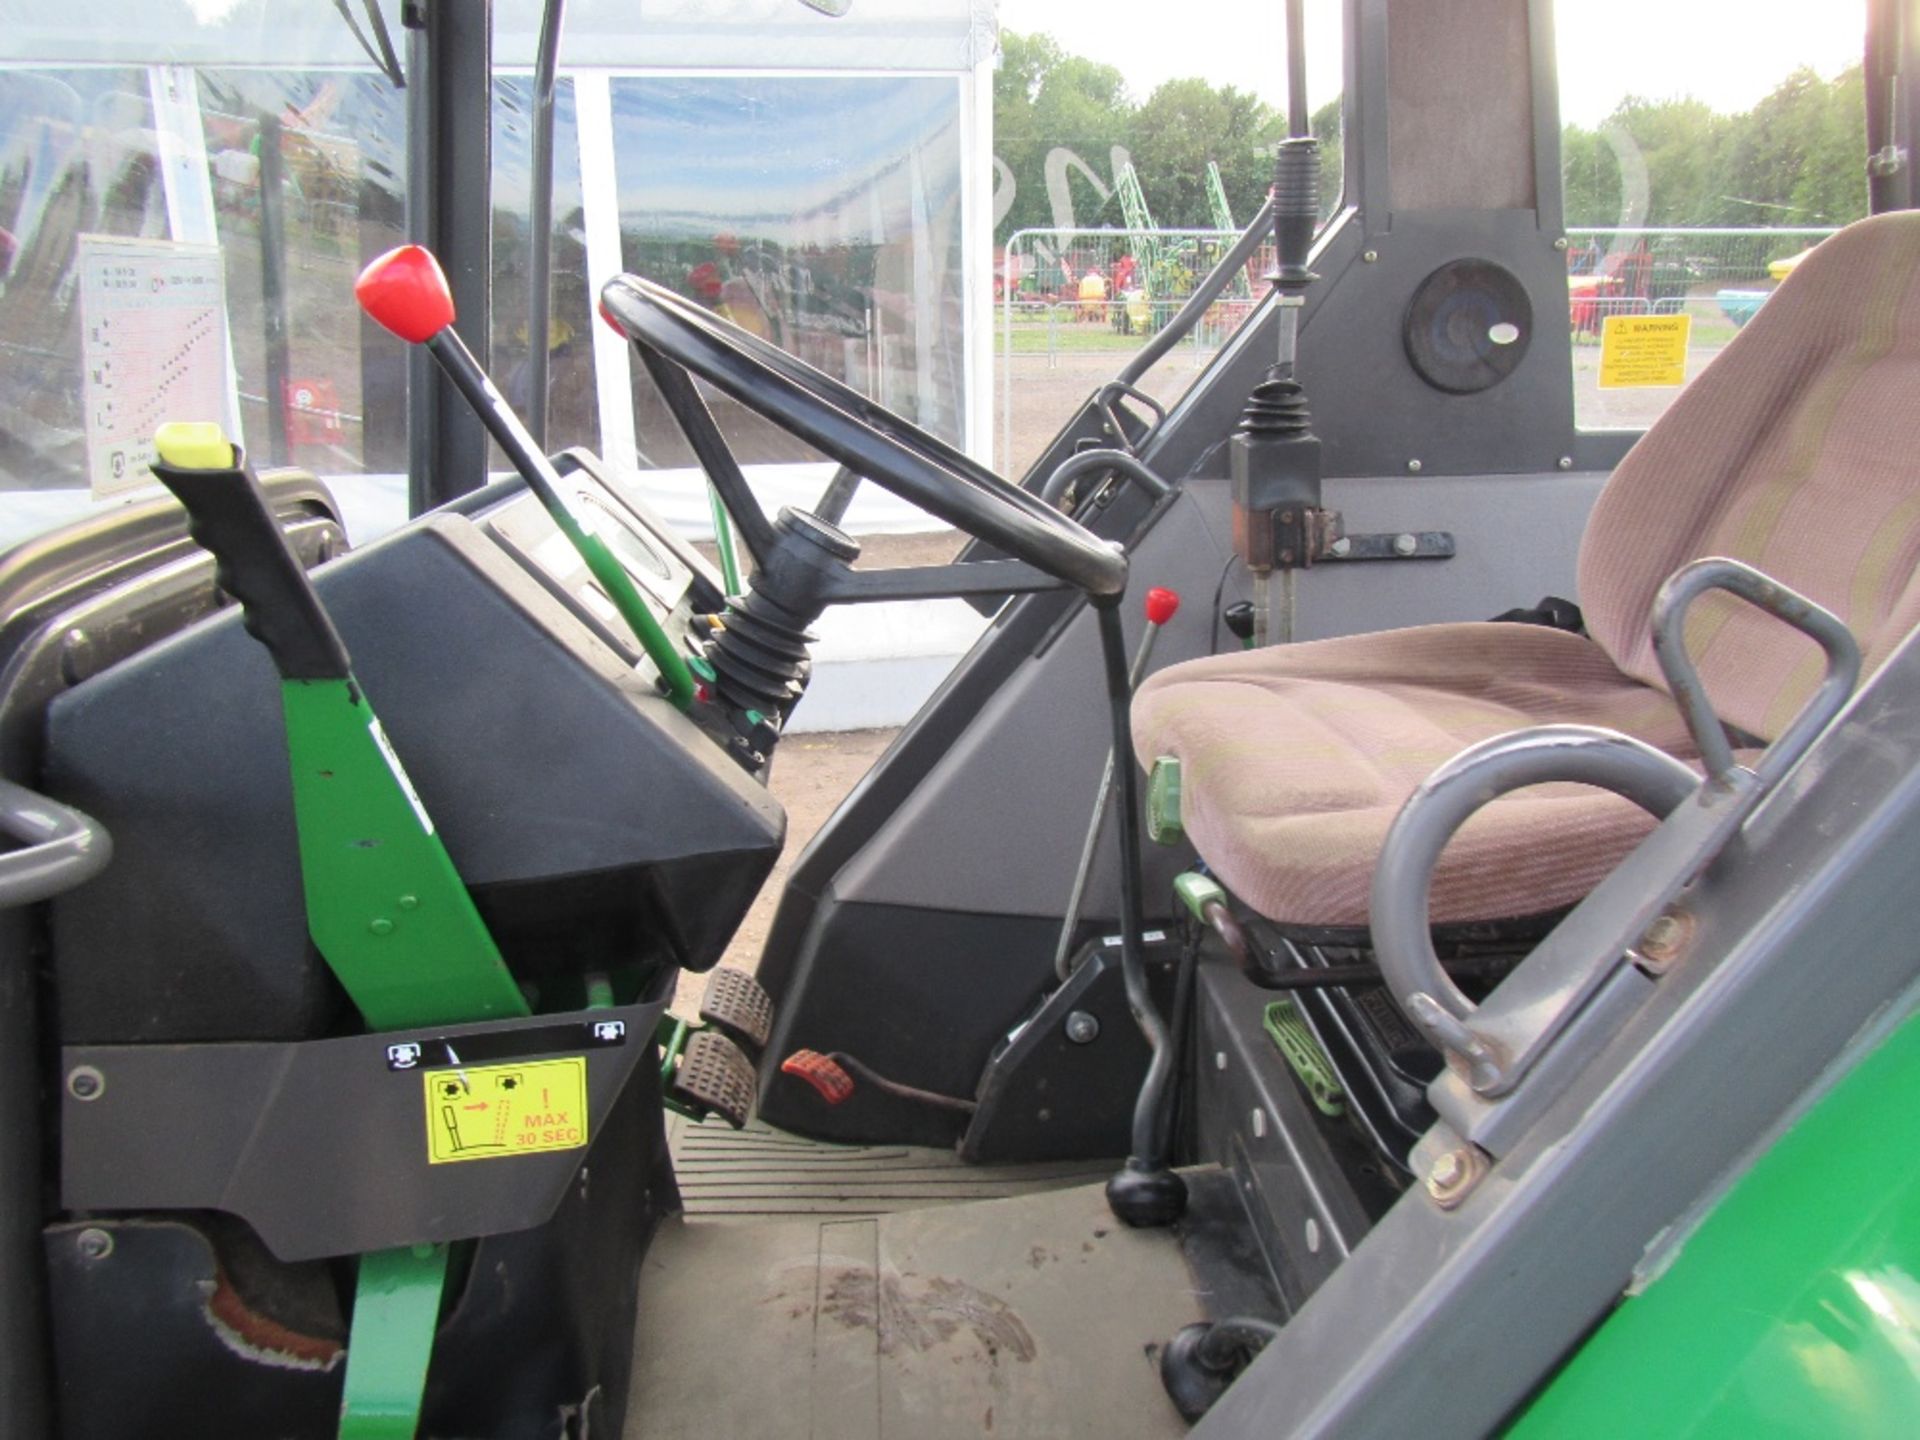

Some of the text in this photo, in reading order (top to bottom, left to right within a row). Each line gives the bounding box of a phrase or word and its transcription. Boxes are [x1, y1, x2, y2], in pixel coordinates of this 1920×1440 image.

[1633, 322, 1679, 332] WARNING
[524, 1112, 569, 1128] MAX
[516, 1128, 578, 1146] 30 SEC
